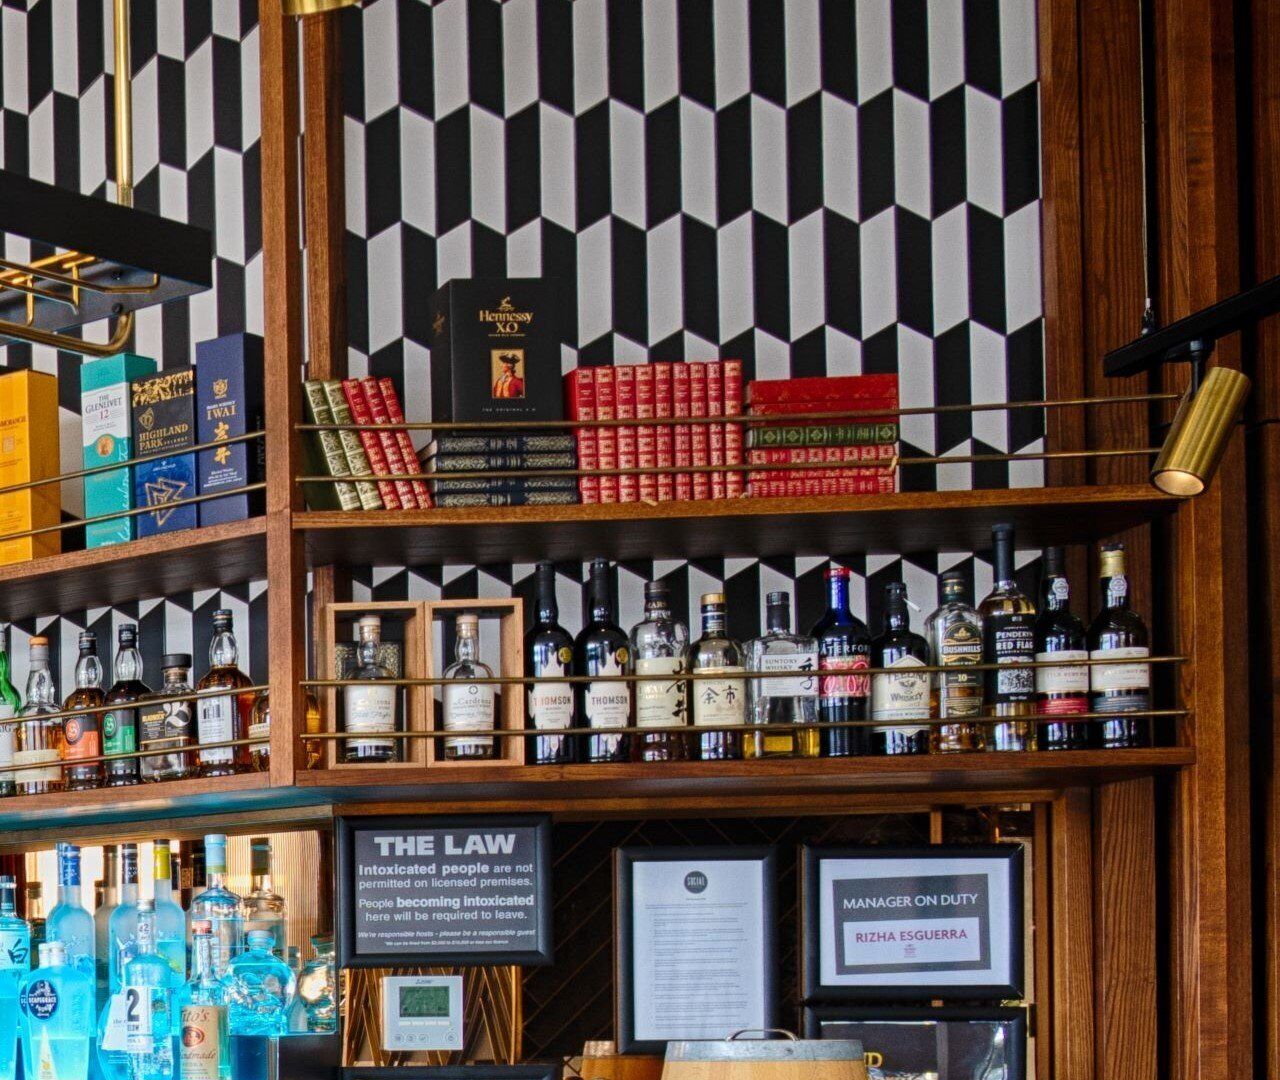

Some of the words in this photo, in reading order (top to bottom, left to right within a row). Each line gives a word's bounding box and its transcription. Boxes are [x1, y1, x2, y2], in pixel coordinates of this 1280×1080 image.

[479, 310, 534, 324] Hennessy
[85, 397, 122, 414] GLENLIVET
[100, 409, 109, 420] 12
[206, 405, 237, 421] IWAI
[139, 422, 189, 441] HIGHLAND
[140, 440, 164, 451] PARK
[996, 641, 1014, 650] RED
[1016, 640, 1033, 649] FLAG
[533, 696, 571, 707] THOMSON
[592, 695, 629, 706] THOMSON
[891, 692, 924, 702] WHISKEY
[374, 835, 435, 856] THE
[444, 834, 516, 855] LAW
[359, 864, 436, 876] Intoxicated
[442, 863, 490, 877] people
[494, 866, 511, 874] are
[515, 863, 533, 873] not
[359, 878, 411, 890] permitted
[414, 880, 428, 888] on
[431, 877, 476, 888] licensed
[480, 877, 533, 889] premises.
[359, 898, 393, 910] People
[396, 896, 460, 909] becoming
[464, 894, 535, 906] intoxicated
[843, 896, 912, 910] MANAGER
[914, 895, 938, 908] ON
[940, 893, 978, 906] DUTY
[365, 911, 390, 921] here
[393, 911, 411, 921] will
[414, 911, 429, 921] be
[432, 910, 477, 922] required
[481, 911, 491, 920] to
[495, 910, 528, 920] leave.
[855, 931, 896, 943] RIZHA
[900, 929, 967, 942] ESGUERRA
